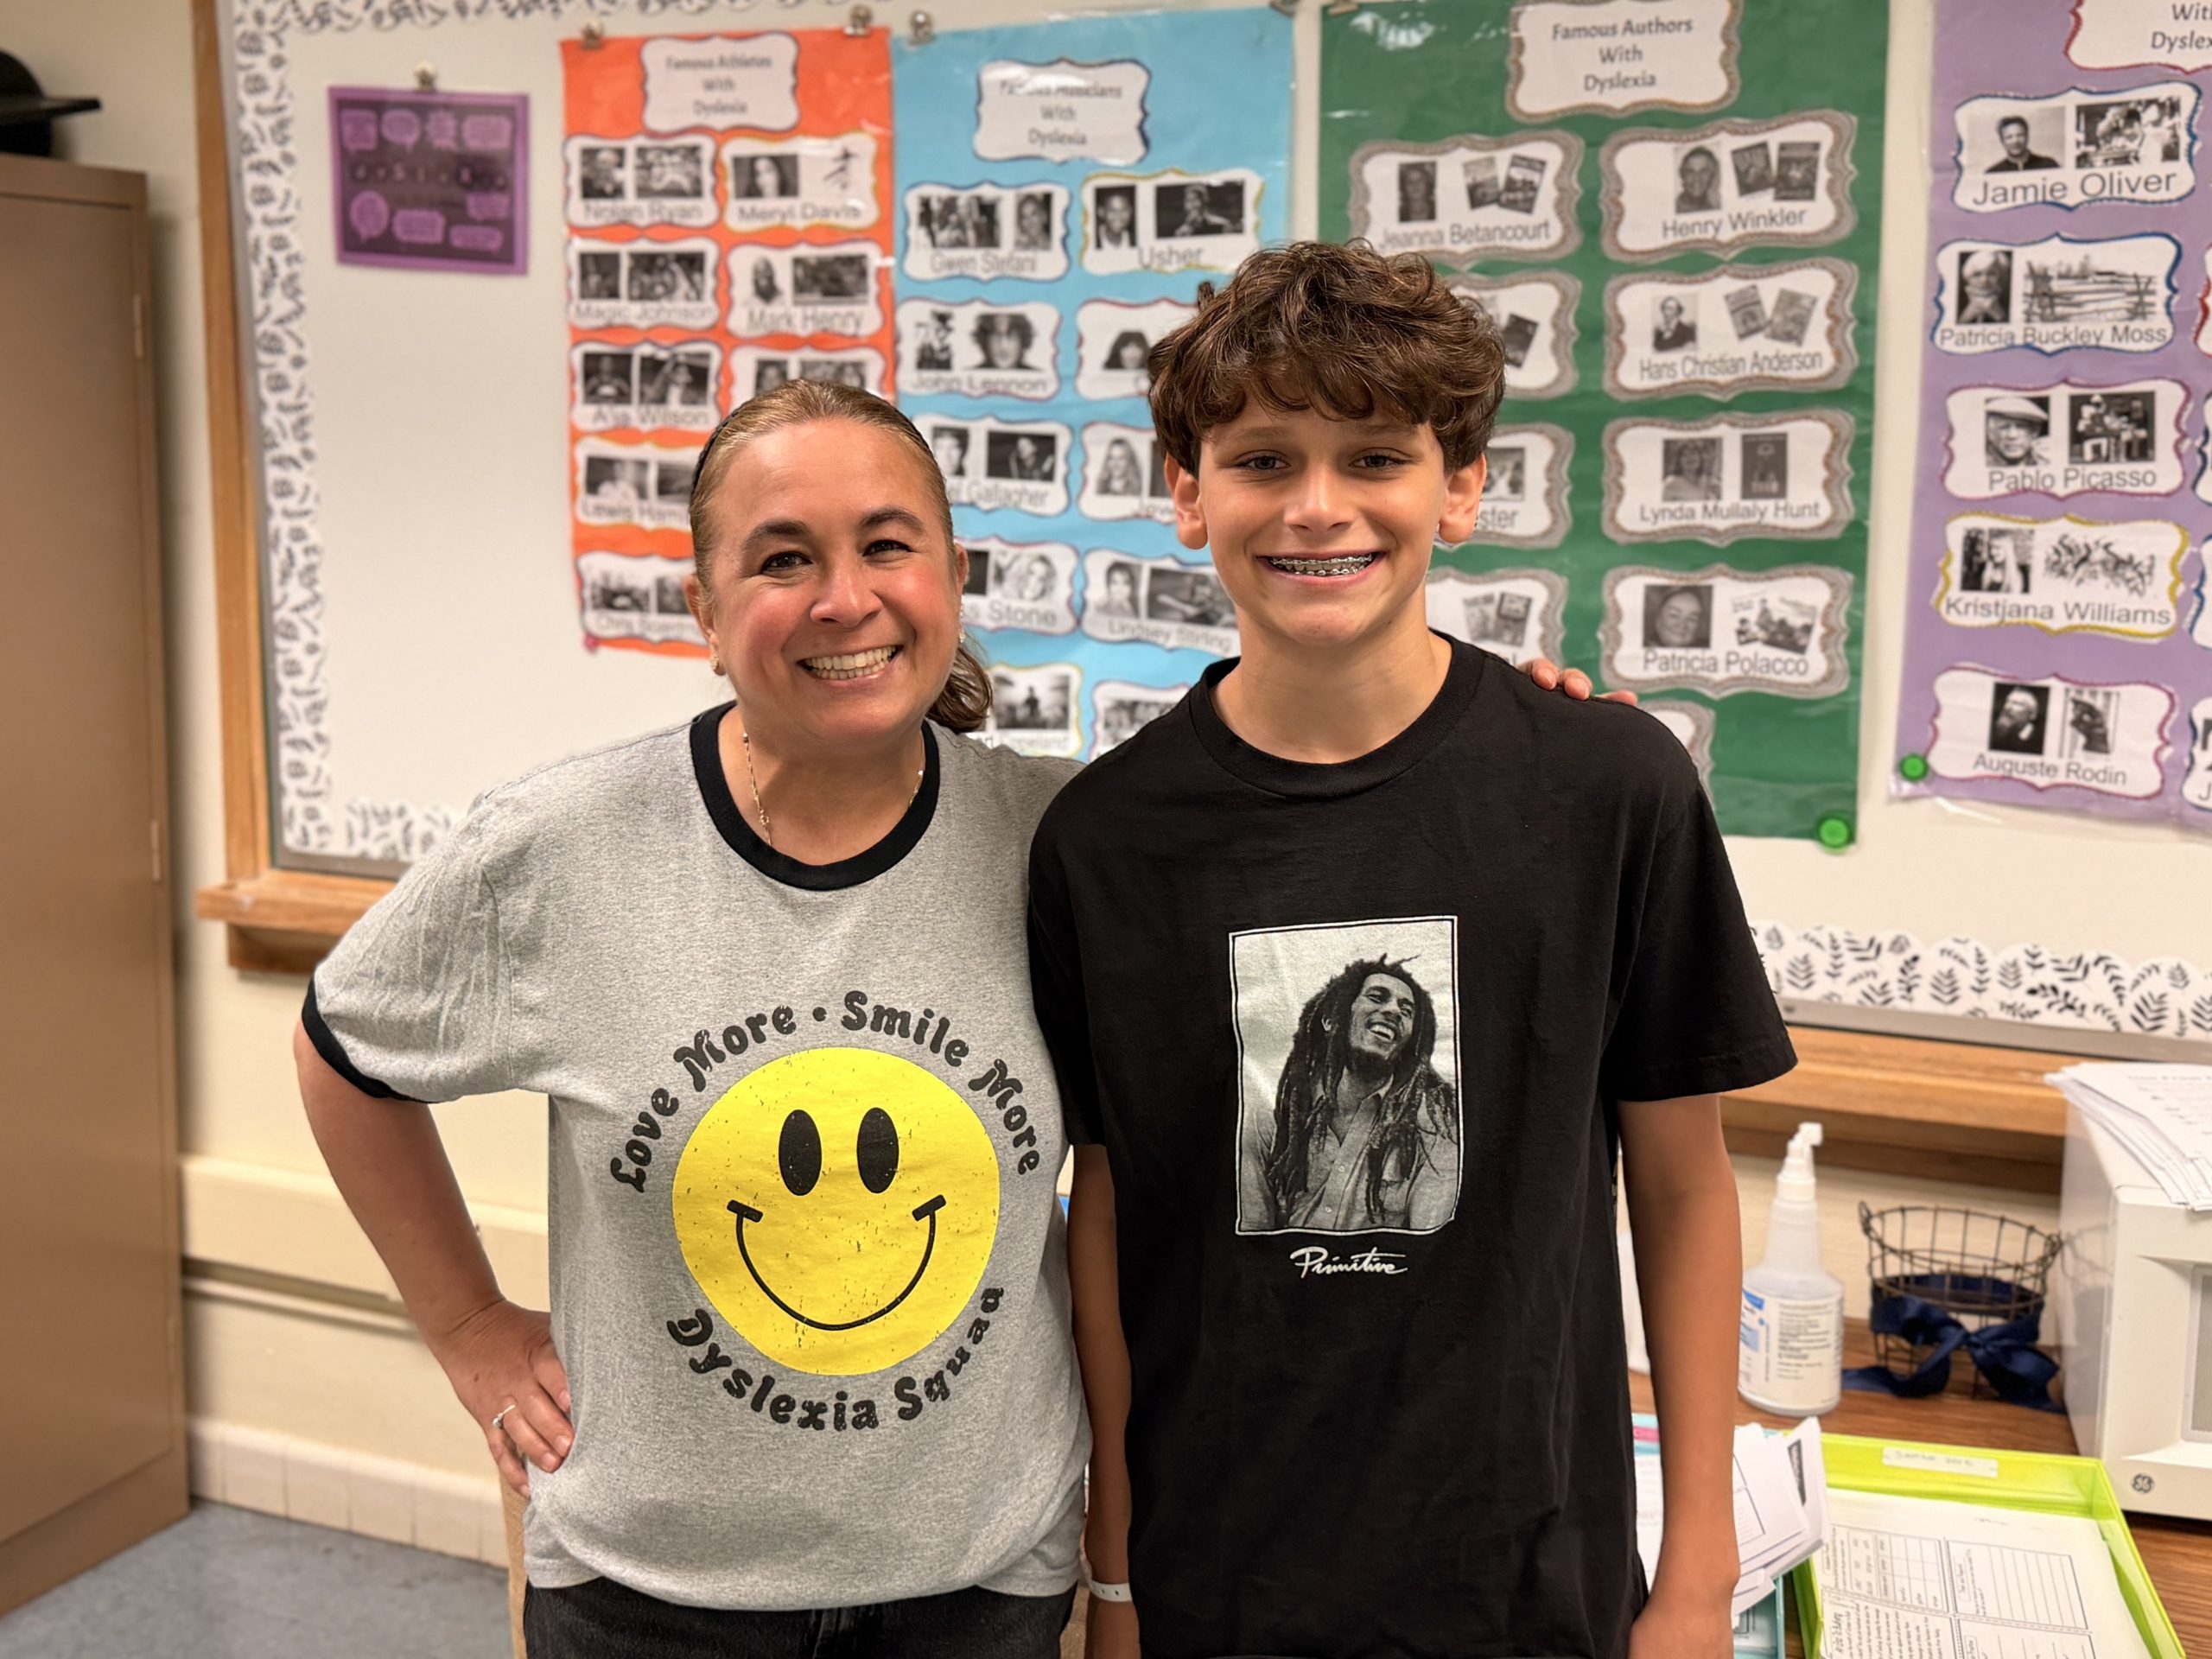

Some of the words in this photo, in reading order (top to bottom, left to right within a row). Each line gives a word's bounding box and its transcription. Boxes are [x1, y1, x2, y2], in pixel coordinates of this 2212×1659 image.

[1553, 20, 1618, 41] Famous
[1622, 16, 1694, 37] Authors
[665, 56, 715, 70] Famous
[717, 54, 772, 69] Athletes
[1599, 46, 1643, 64] With
[702, 78, 736, 92] With
[1583, 71, 1656, 92] Dyslexia
[693, 99, 748, 118] Dyslexia
[1039, 104, 1077, 121] With
[1027, 127, 1088, 149] Dyslexia
[1972, 178, 2069, 207] Jamie
[2080, 169, 2177, 199] Oliver
[800, 200, 862, 220] Davis
[1449, 218, 1551, 245] Betancourt
[1662, 216, 1723, 241] Henry
[1726, 206, 1808, 232] Winkler
[1137, 243, 1205, 269] Usher
[747, 307, 796, 332] Mark
[800, 308, 865, 333] Henry
[1940, 327, 2017, 347] Patricia
[2023, 327, 2105, 350] Buckley
[2111, 324, 2168, 345] Moss
[1640, 358, 1678, 380] Hans
[1680, 353, 1747, 378] Christian
[1750, 347, 1824, 371] Anderson
[966, 374, 1048, 393] Lennon
[1988, 468, 2056, 492] Pablo
[2064, 467, 2158, 489] Picasso
[1640, 504, 1696, 524] Lynda
[1700, 503, 1770, 524] Mullaly
[1772, 501, 1821, 520] Hunt
[988, 600, 1058, 626] Stone
[2063, 601, 2172, 626] Williams
[1643, 650, 1719, 674] Patricia
[1725, 650, 1810, 677] Polacco
[1973, 752, 2059, 779] Auguste
[2066, 760, 2127, 787] Rodin
[610, 1087, 680, 1194] Love
[673, 1005, 798, 1092] More
[840, 989, 971, 1068] Smile
[968, 1058, 1041, 1176] More
[1289, 1245, 1409, 1281] Primitive
[665, 1307, 880, 1433] Dyslexia
[893, 1286, 1005, 1421] Squad
